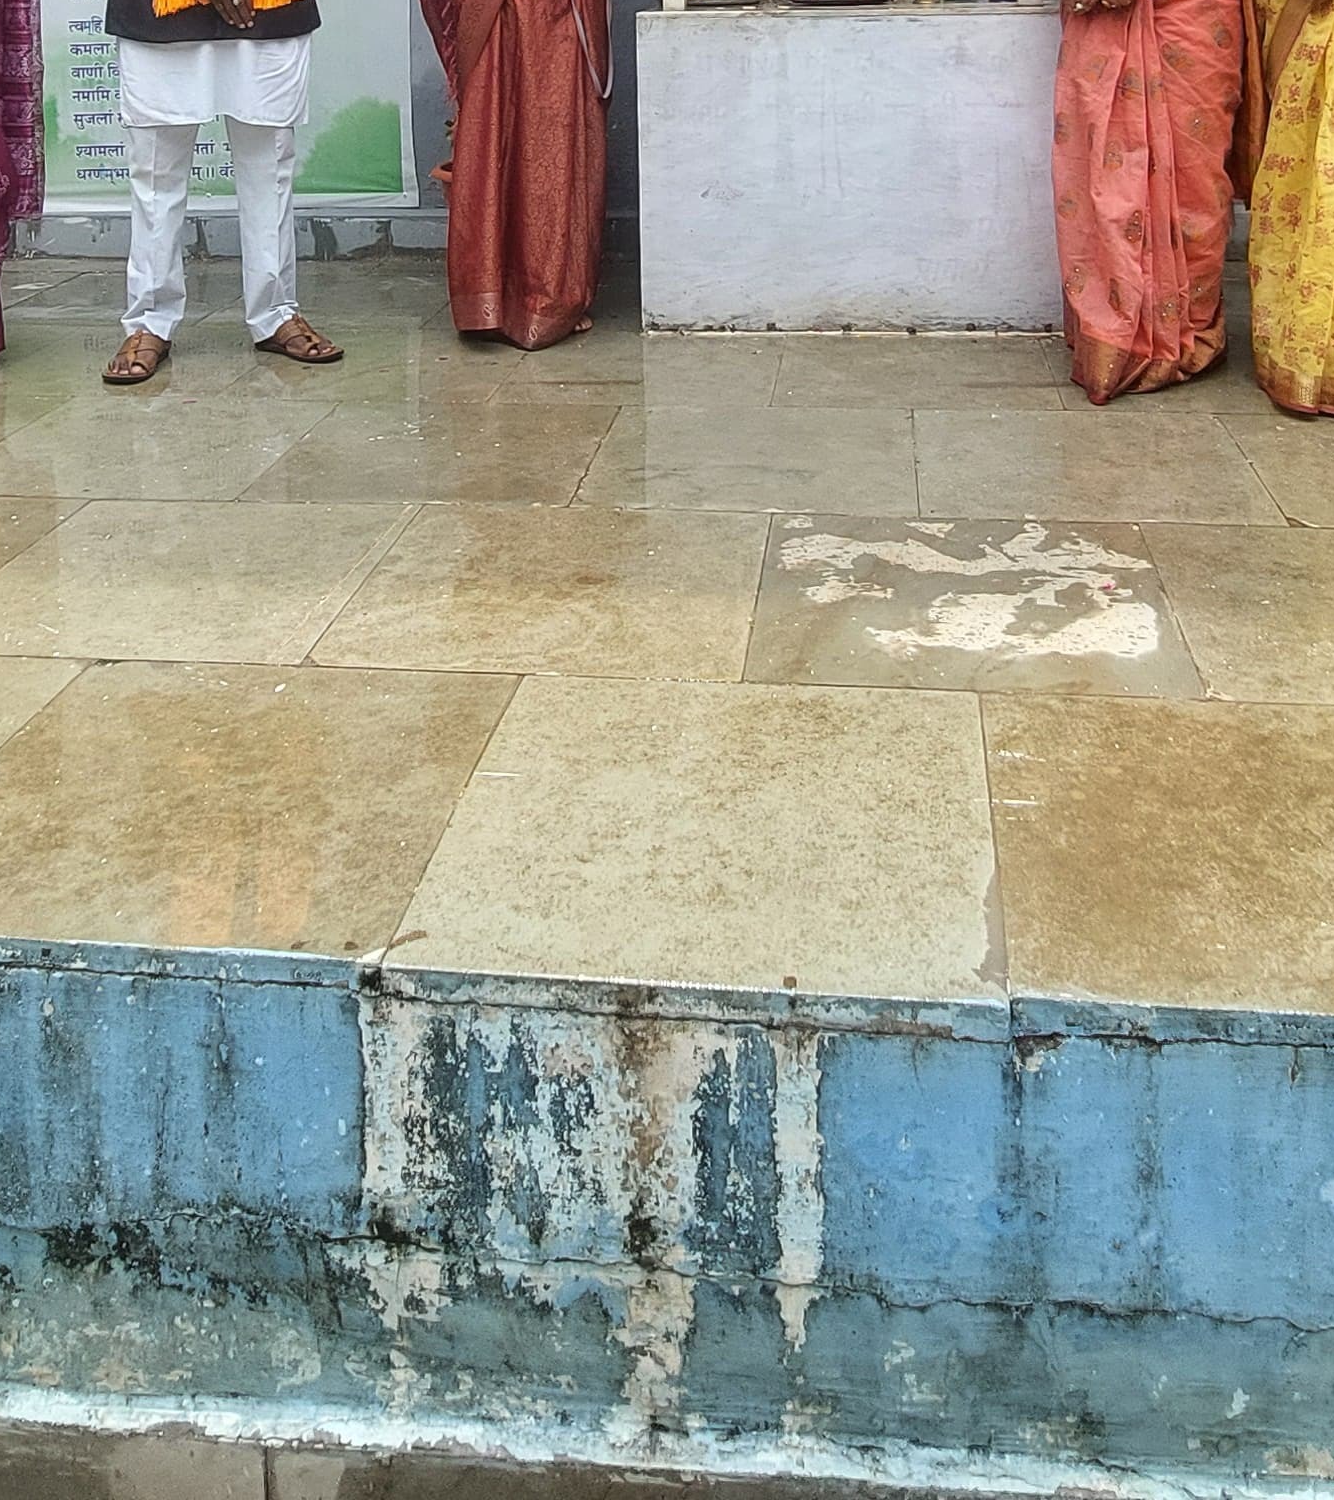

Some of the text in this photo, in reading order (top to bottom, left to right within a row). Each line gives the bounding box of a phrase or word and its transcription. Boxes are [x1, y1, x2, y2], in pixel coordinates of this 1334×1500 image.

[70, 43, 110, 57] कमला
[71, 62, 104, 79] वाणी
[72, 86, 111, 102] नमामि
[73, 109, 114, 131] सुजलां
[76, 141, 125, 158] श्यामलां
